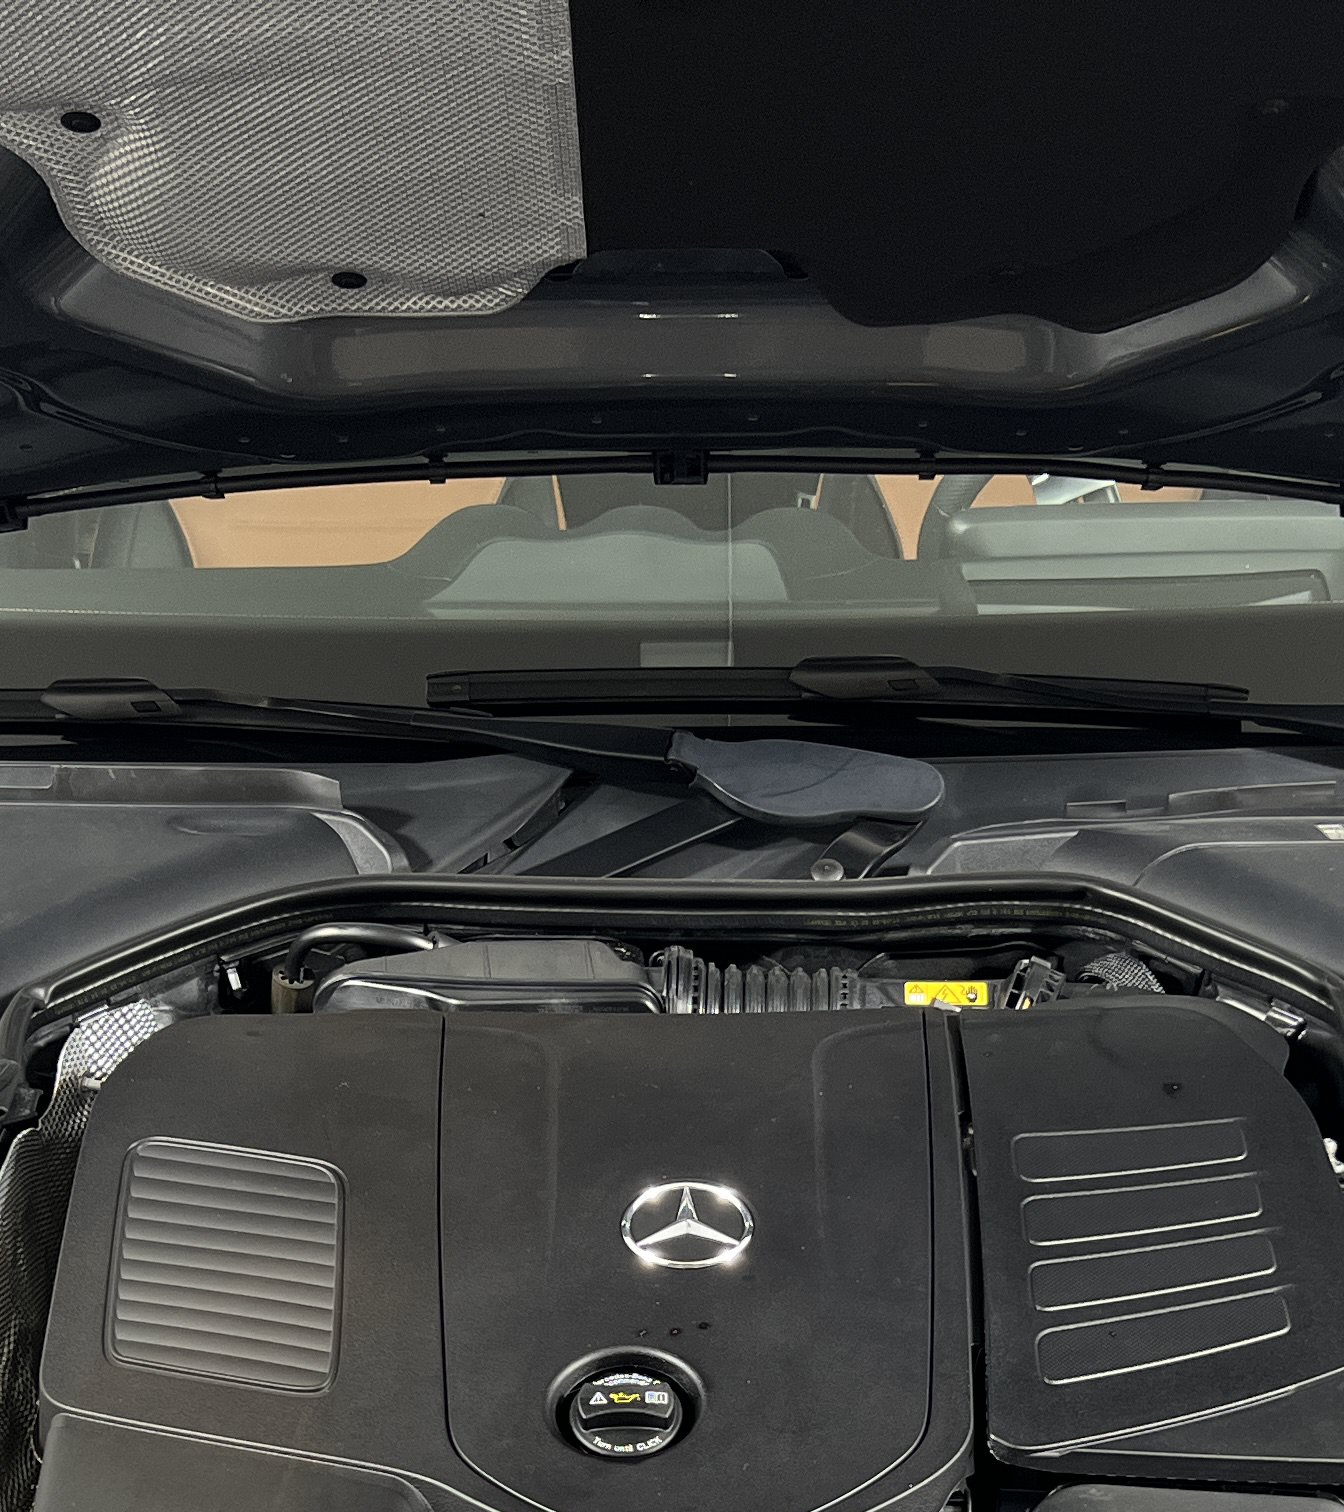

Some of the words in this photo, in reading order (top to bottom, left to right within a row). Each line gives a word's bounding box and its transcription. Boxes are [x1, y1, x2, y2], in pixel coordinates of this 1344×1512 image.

[593, 1436, 612, 1450] Turn
[614, 1444, 634, 1452] until
[636, 1436, 663, 1451] CLICK
